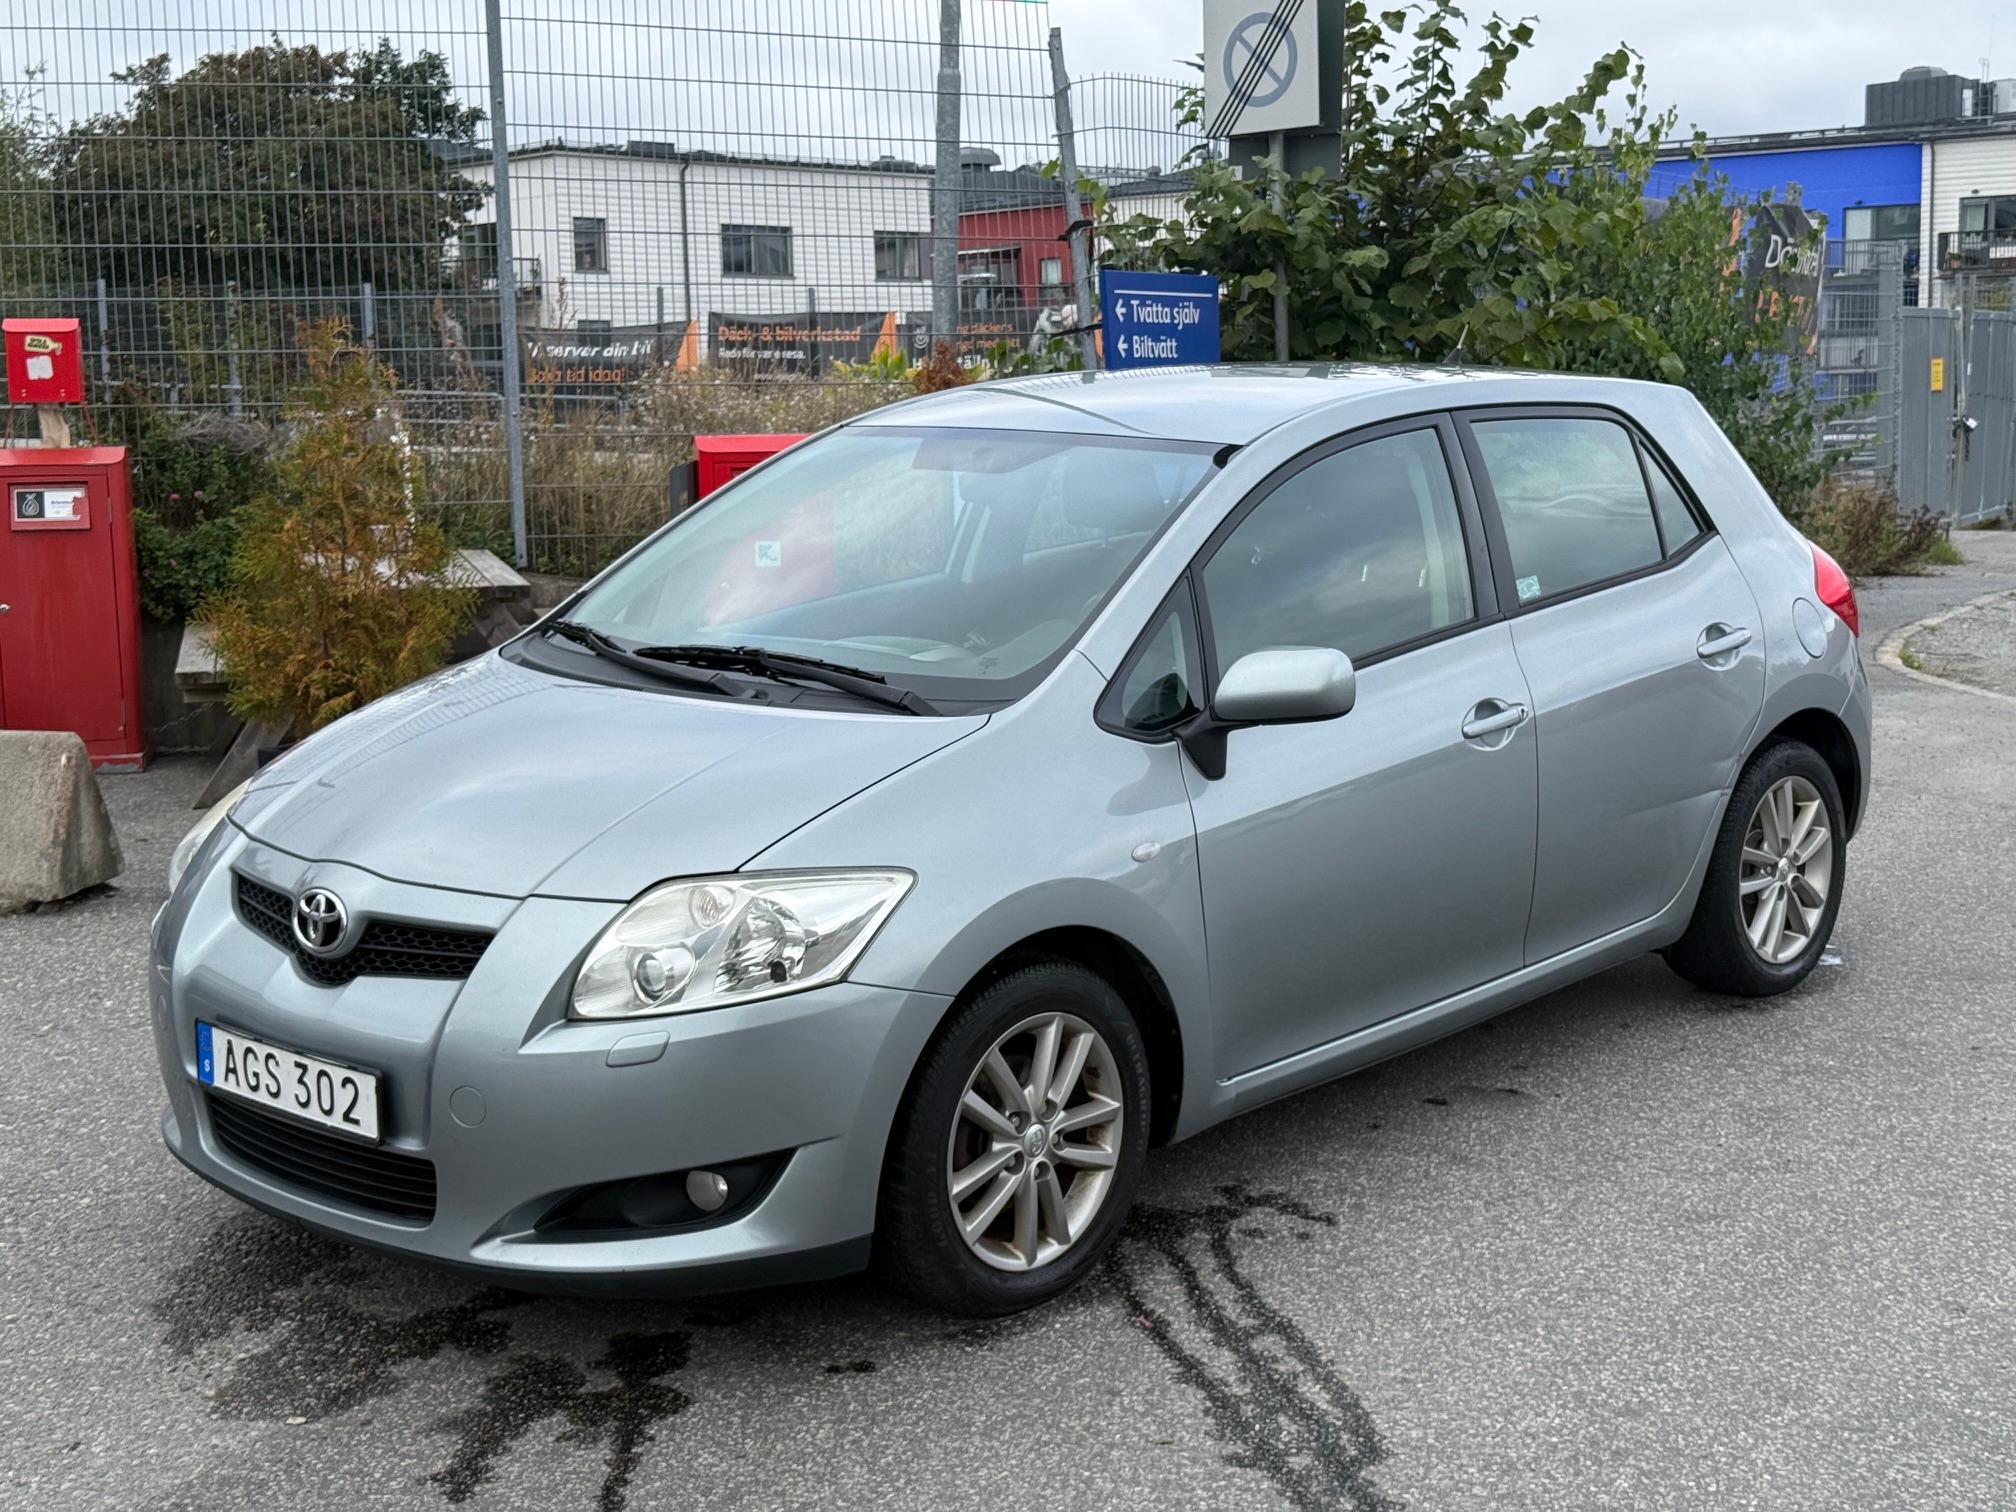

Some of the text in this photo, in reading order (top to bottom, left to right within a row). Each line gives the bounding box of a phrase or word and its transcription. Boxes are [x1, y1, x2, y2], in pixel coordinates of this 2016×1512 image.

[1130, 300, 1200, 330] Tvätta själv
[761, 327, 772, 341] &
[775, 326, 861, 341] bilverkstad
[1132, 335, 1178, 358] Biltvätt
[204, 1058, 211, 1072] S
[223, 1038, 361, 1126] AGS 302
